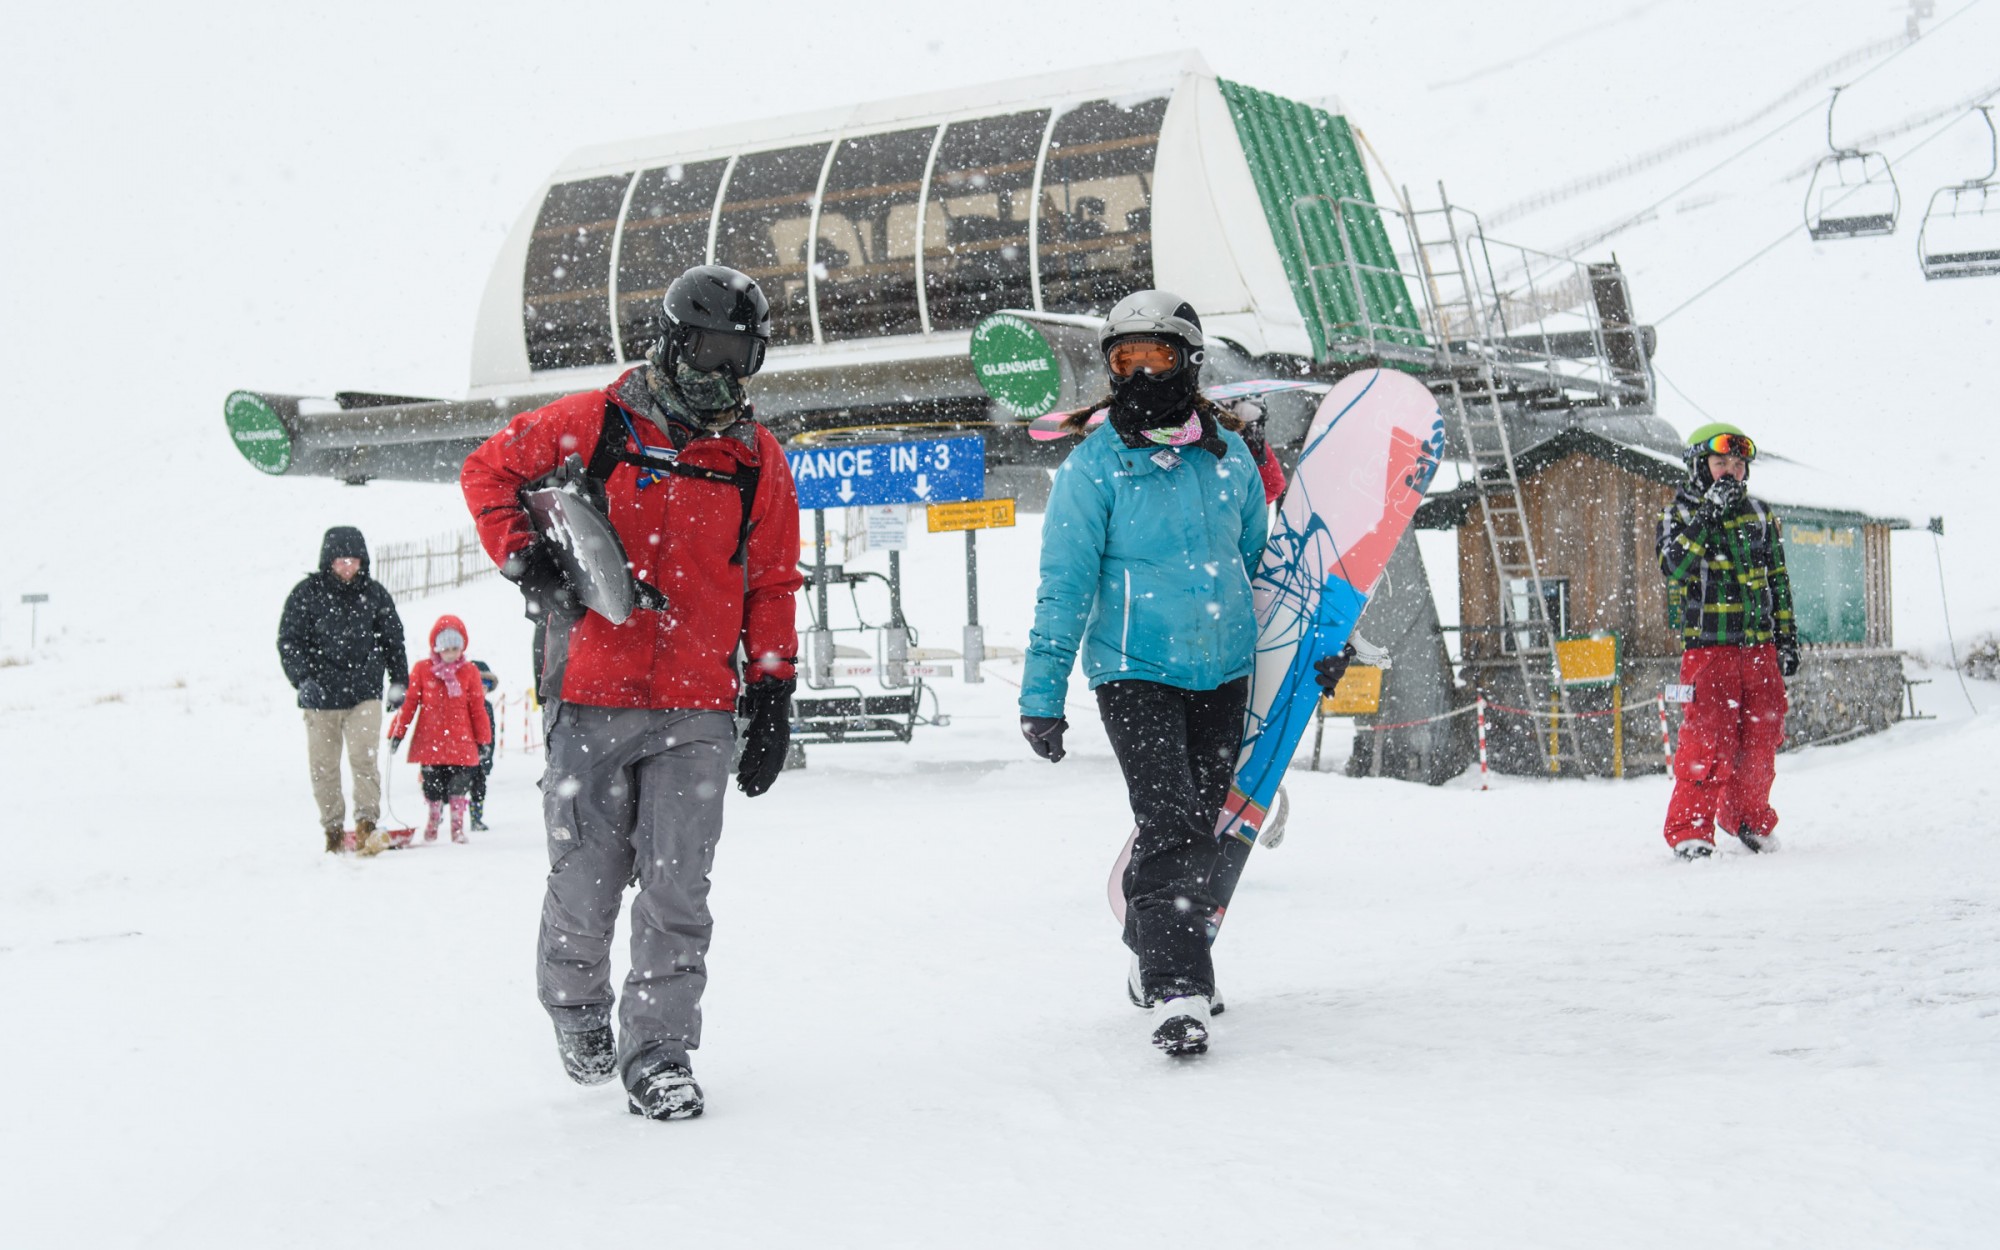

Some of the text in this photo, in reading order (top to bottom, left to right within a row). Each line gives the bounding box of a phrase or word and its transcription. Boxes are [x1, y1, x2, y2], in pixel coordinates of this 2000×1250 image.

[975, 314, 1035, 341] CAIRNWELL
[982, 358, 1050, 377] GLENSHEE
[997, 391, 1057, 418] CHAIRLIFT
[889, 445, 917, 473] IN
[934, 444, 950, 471] 3
[847, 667, 872, 675] STOP
